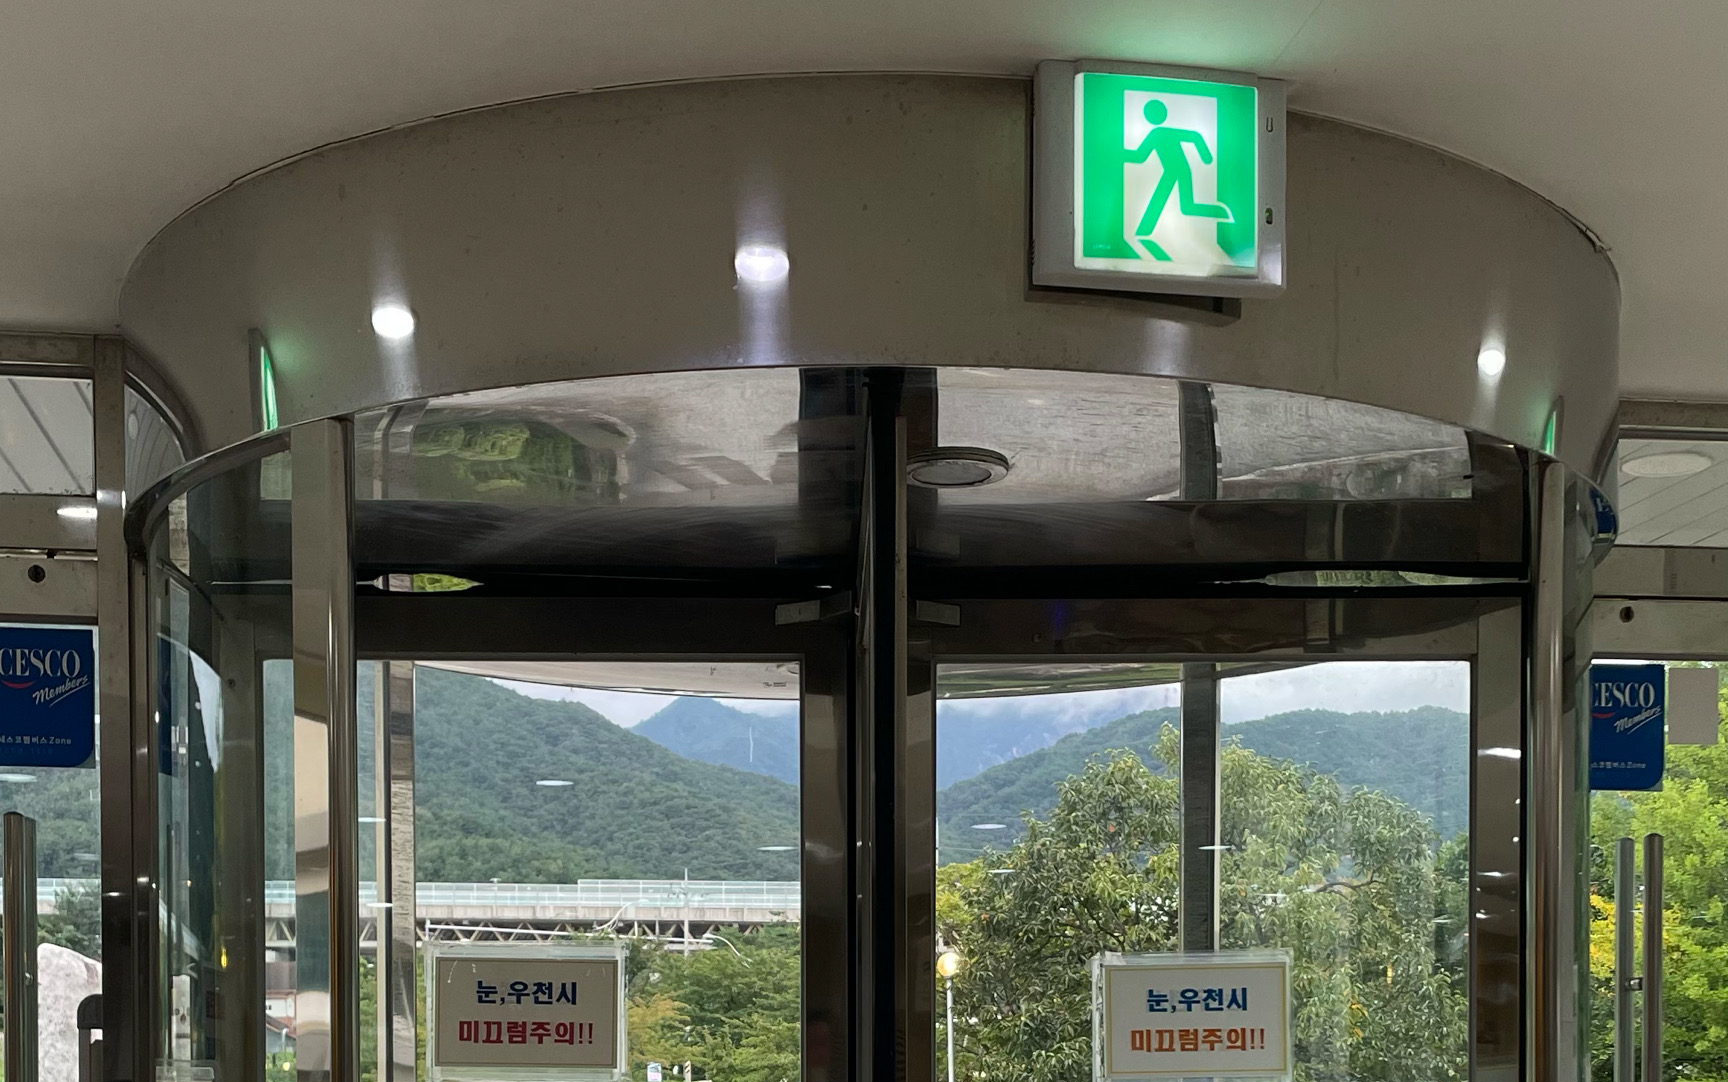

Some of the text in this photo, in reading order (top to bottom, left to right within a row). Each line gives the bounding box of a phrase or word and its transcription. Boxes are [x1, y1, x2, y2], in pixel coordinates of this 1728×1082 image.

[0, 648, 81, 677] CESCO
[32, 674, 89, 705] Members
[476, 980, 578, 1006] 눈,우천시
[1146, 987, 1248, 1013] 눈,우천시
[458, 1020, 594, 1045] 미끄럼주의!!
[1130, 1027, 1265, 1053] 미끄럼주의!!
